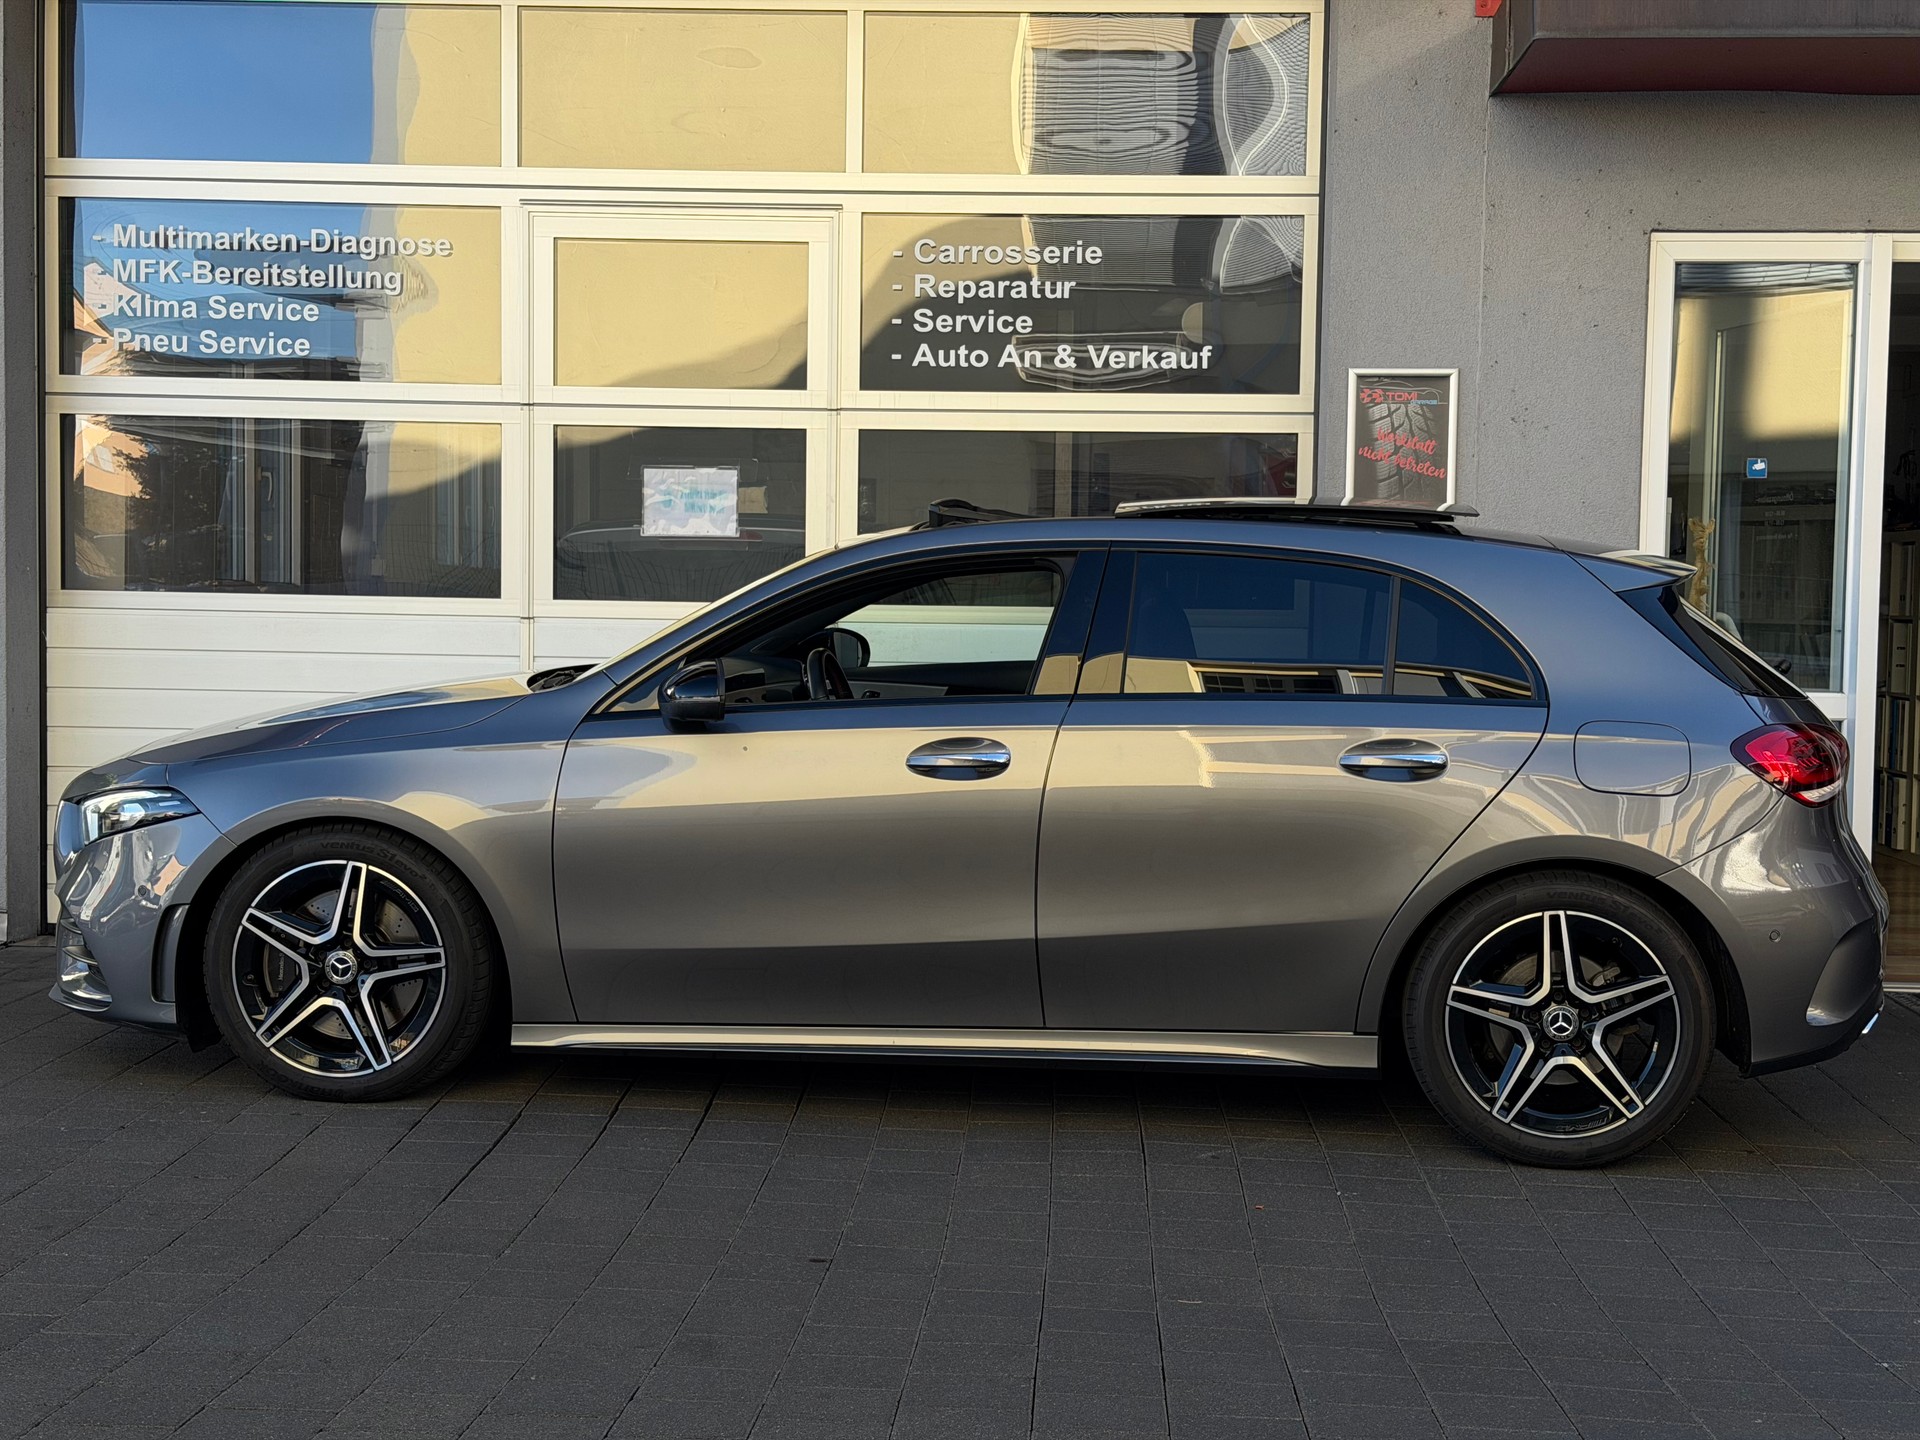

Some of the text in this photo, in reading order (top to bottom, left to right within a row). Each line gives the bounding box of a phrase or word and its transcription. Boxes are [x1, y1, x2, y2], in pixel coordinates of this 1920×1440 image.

[113, 223, 454, 260] Multimarken-Diagnose
[914, 239, 1103, 264] Carrosserie
[113, 258, 404, 296] MFK-Bereitstellung
[914, 274, 1075, 303] Reparatur
[113, 294, 198, 320] Klima
[207, 295, 320, 322] Service
[913, 308, 1033, 334] Service
[113, 327, 188, 354] Pneu
[199, 329, 311, 357] Service
[912, 343, 989, 368] Auto
[997, 344, 1042, 368] An
[1054, 344, 1077, 369] &
[1087, 345, 1213, 370] Verkauf
[1386, 391, 1418, 401] TOMI
[1377, 427, 1437, 455] Werkstatt
[1394, 452, 1446, 478] betreten
